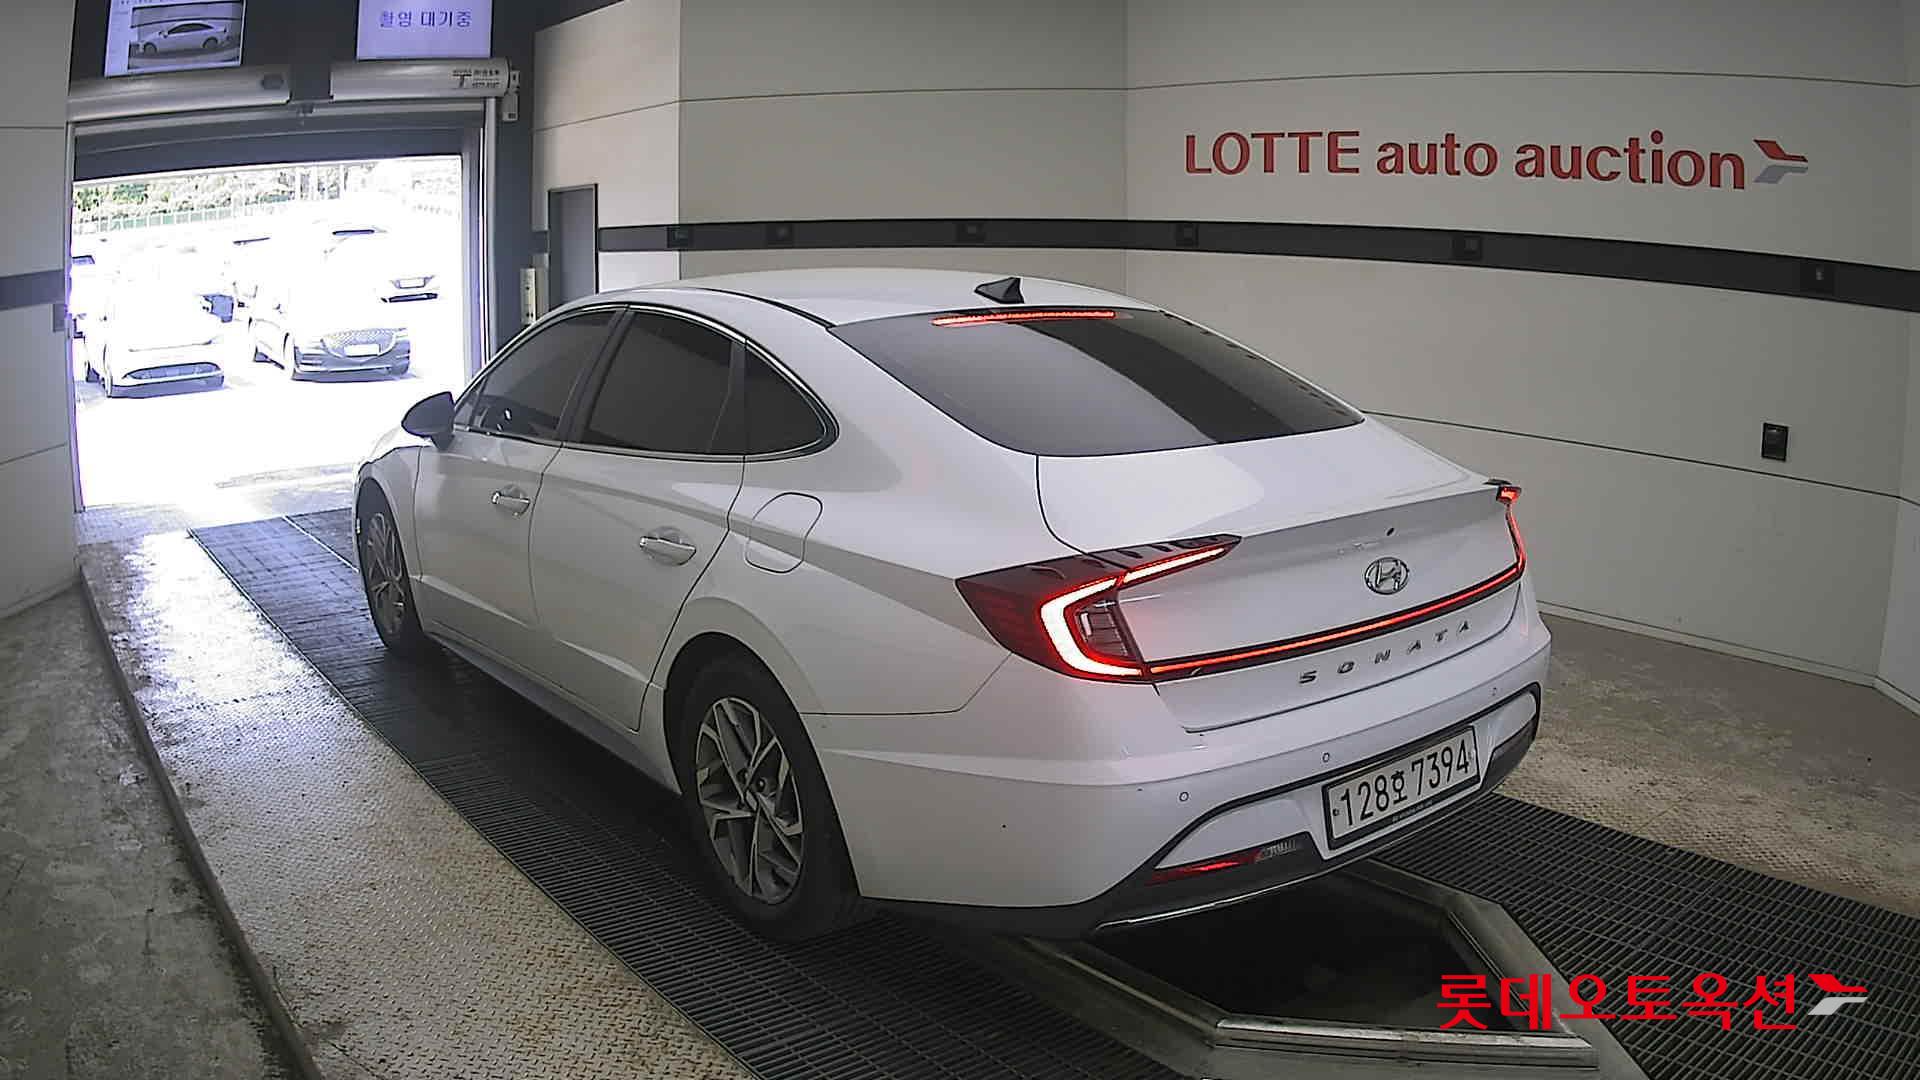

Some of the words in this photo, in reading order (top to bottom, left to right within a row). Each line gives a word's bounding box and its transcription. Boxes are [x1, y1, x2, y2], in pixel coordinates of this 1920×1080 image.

[420, 10, 473, 28] 대기중
[1185, 130, 1360, 176] LOTTE
[1376, 132, 1499, 177] auto
[1515, 129, 1747, 190] auction
[1298, 620, 1470, 684] SONATA
[1340, 769, 1409, 827] 128호
[1411, 738, 1470, 797] 7394
